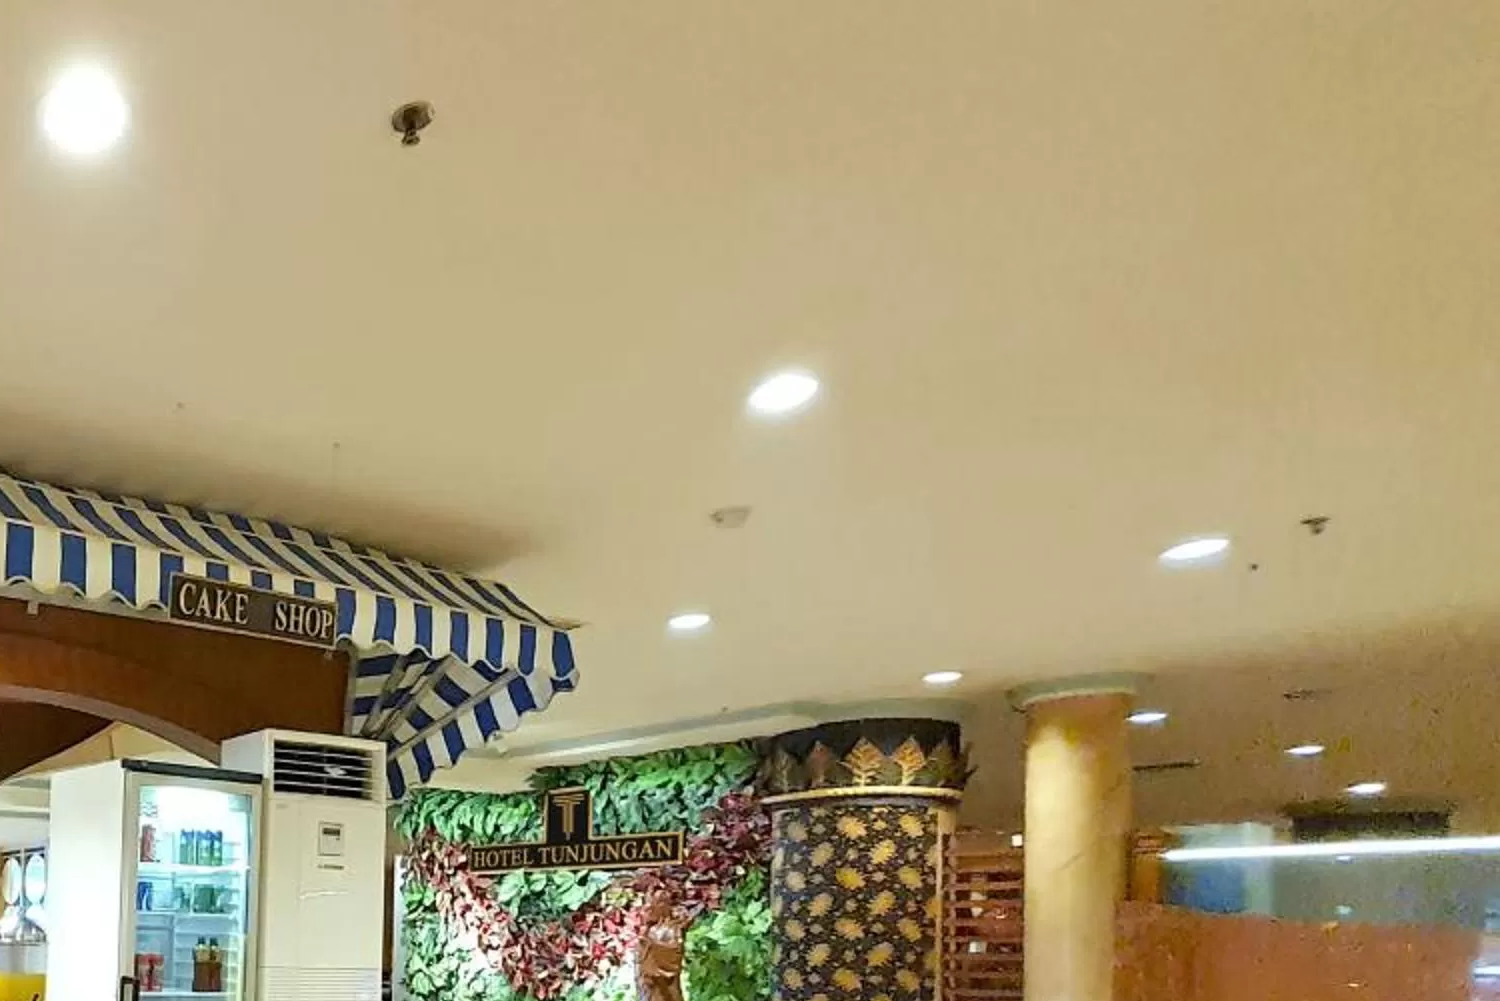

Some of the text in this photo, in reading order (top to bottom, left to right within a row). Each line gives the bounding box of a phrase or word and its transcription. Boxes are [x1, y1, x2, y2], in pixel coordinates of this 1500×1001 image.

[179, 583, 333, 639] CAKE SHOP
[553, 794, 585, 840] T
[473, 839, 673, 868] HOTEL TUNJUNGAN
